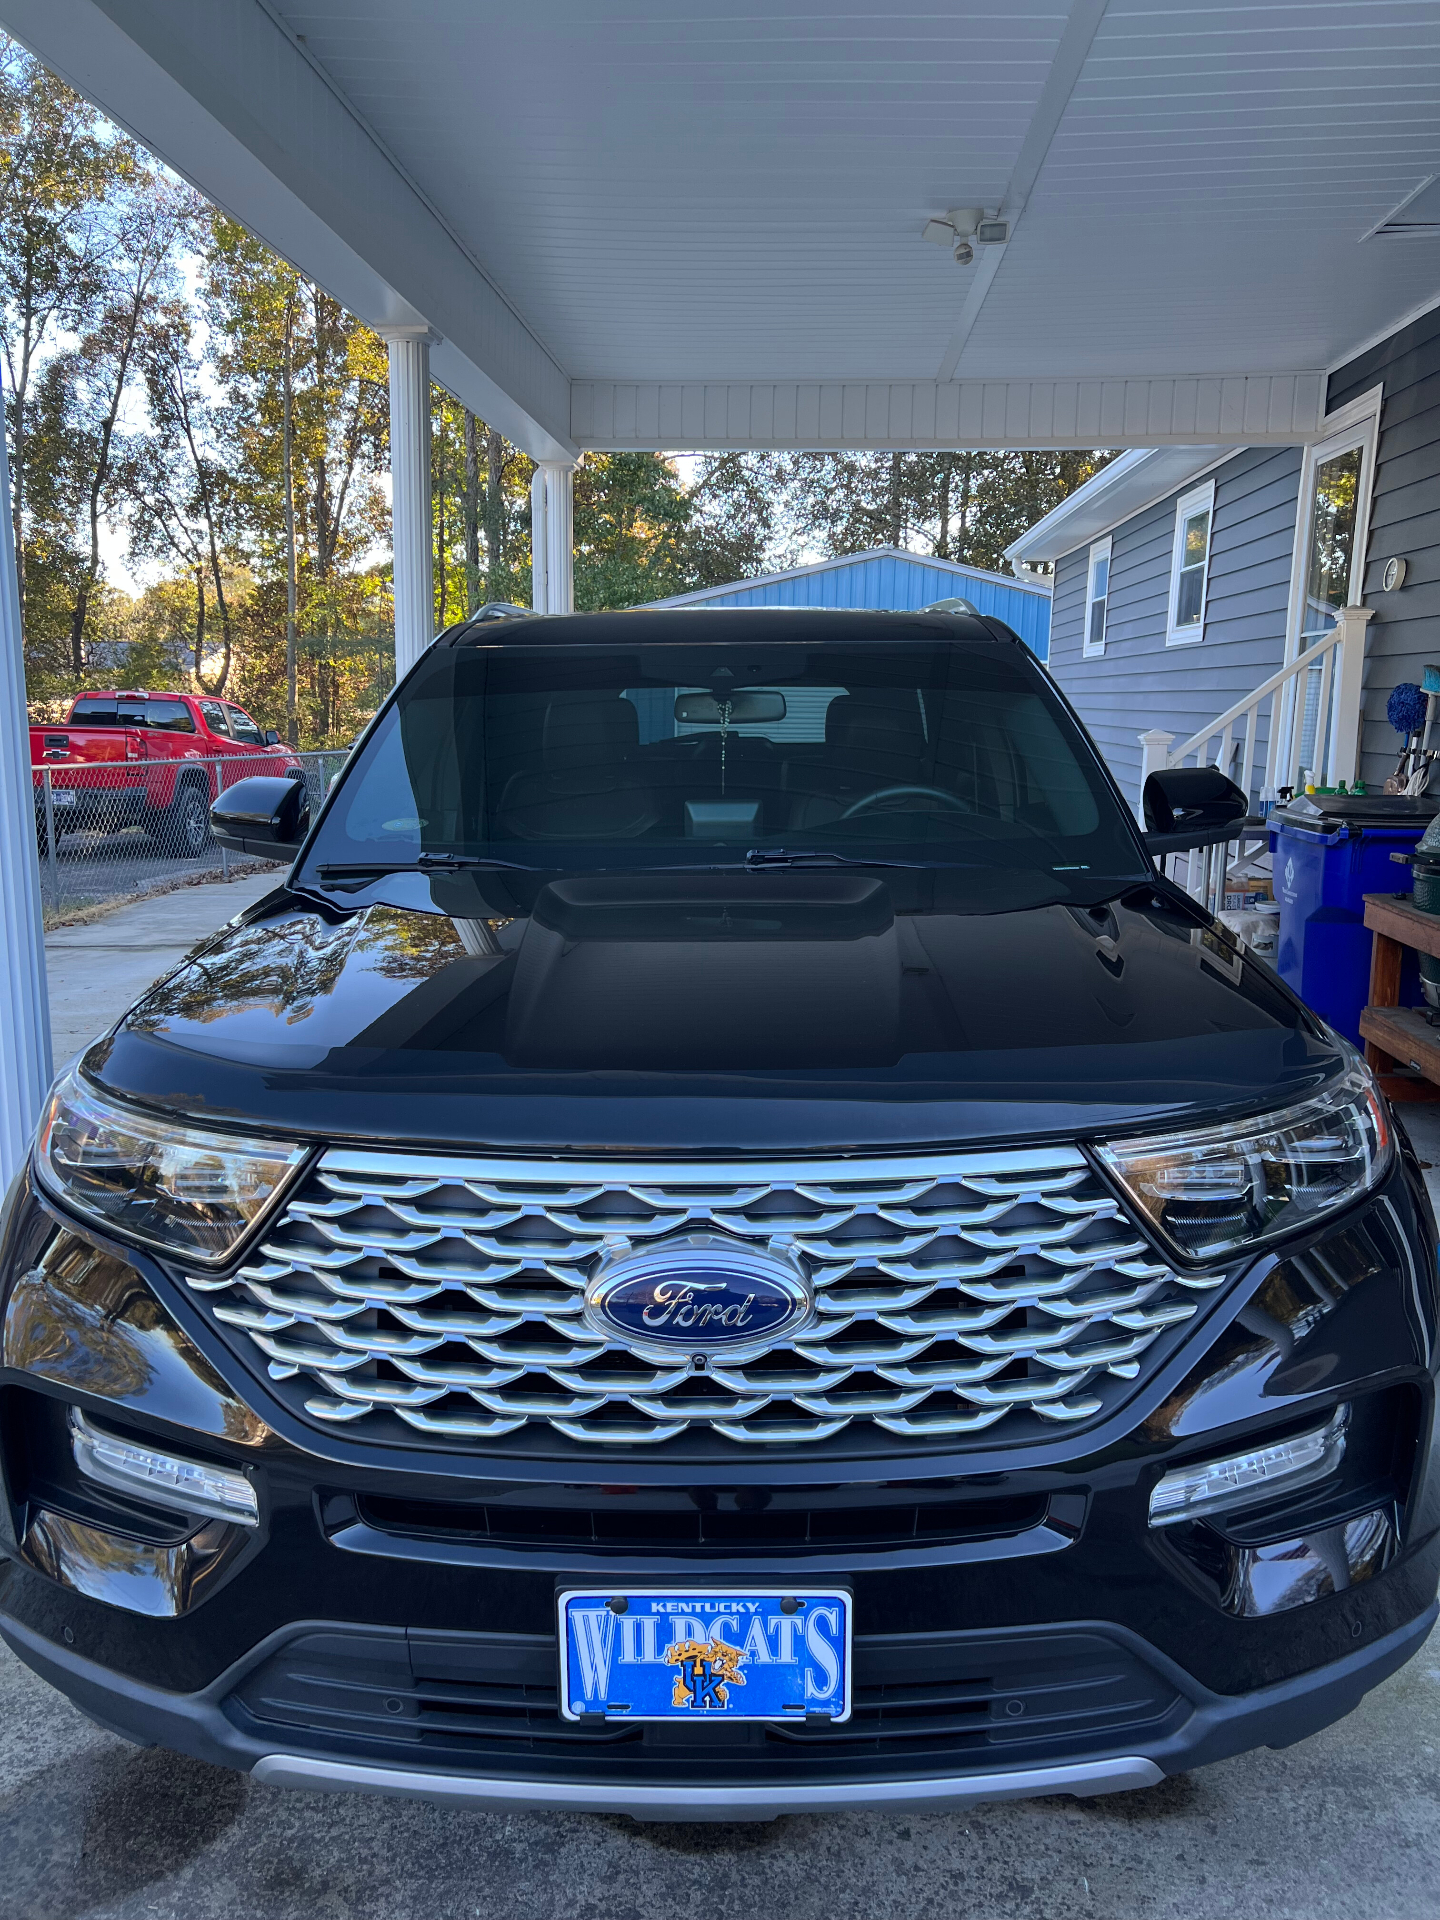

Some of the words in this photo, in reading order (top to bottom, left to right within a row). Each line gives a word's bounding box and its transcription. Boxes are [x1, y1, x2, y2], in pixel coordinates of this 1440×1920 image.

[642, 1281, 755, 1327] Ford
[651, 1602, 760, 1613] KENTUCKY
[569, 1607, 840, 1700] WILDCATS
[681, 1659, 726, 1709] UK
